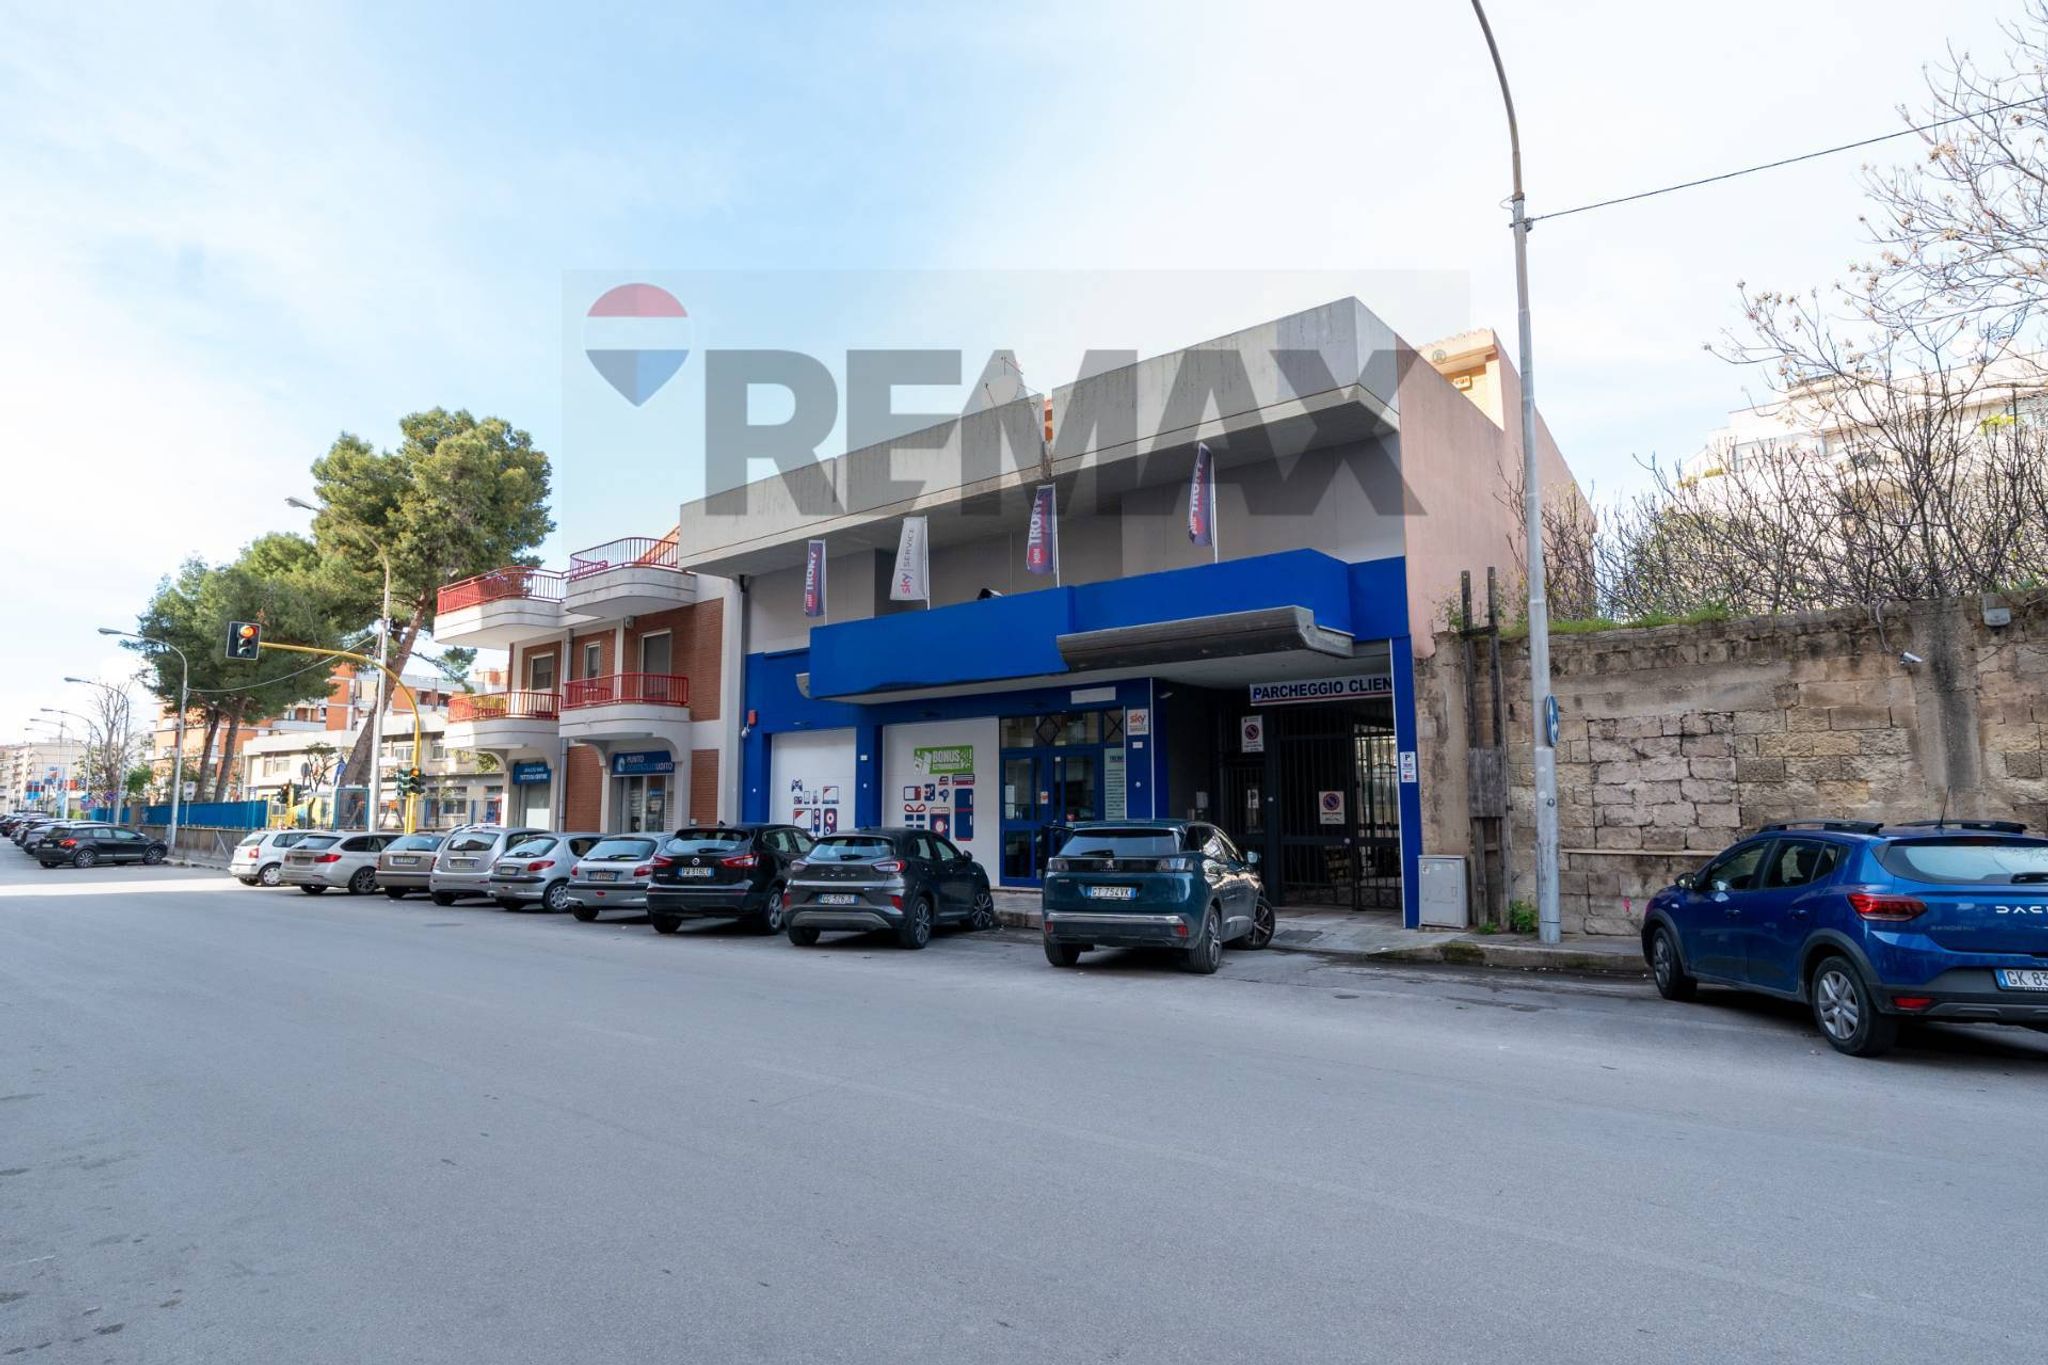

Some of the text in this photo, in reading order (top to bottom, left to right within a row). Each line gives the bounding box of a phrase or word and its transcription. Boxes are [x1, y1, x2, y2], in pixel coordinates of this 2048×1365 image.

[901, 574, 913, 594] sky
[1252, 681, 1344, 700] PARCHEGGIO
[1130, 713, 1146, 725] sky
[932, 749, 961, 763] BONUS
[2006, 970, 2028, 986] GK
